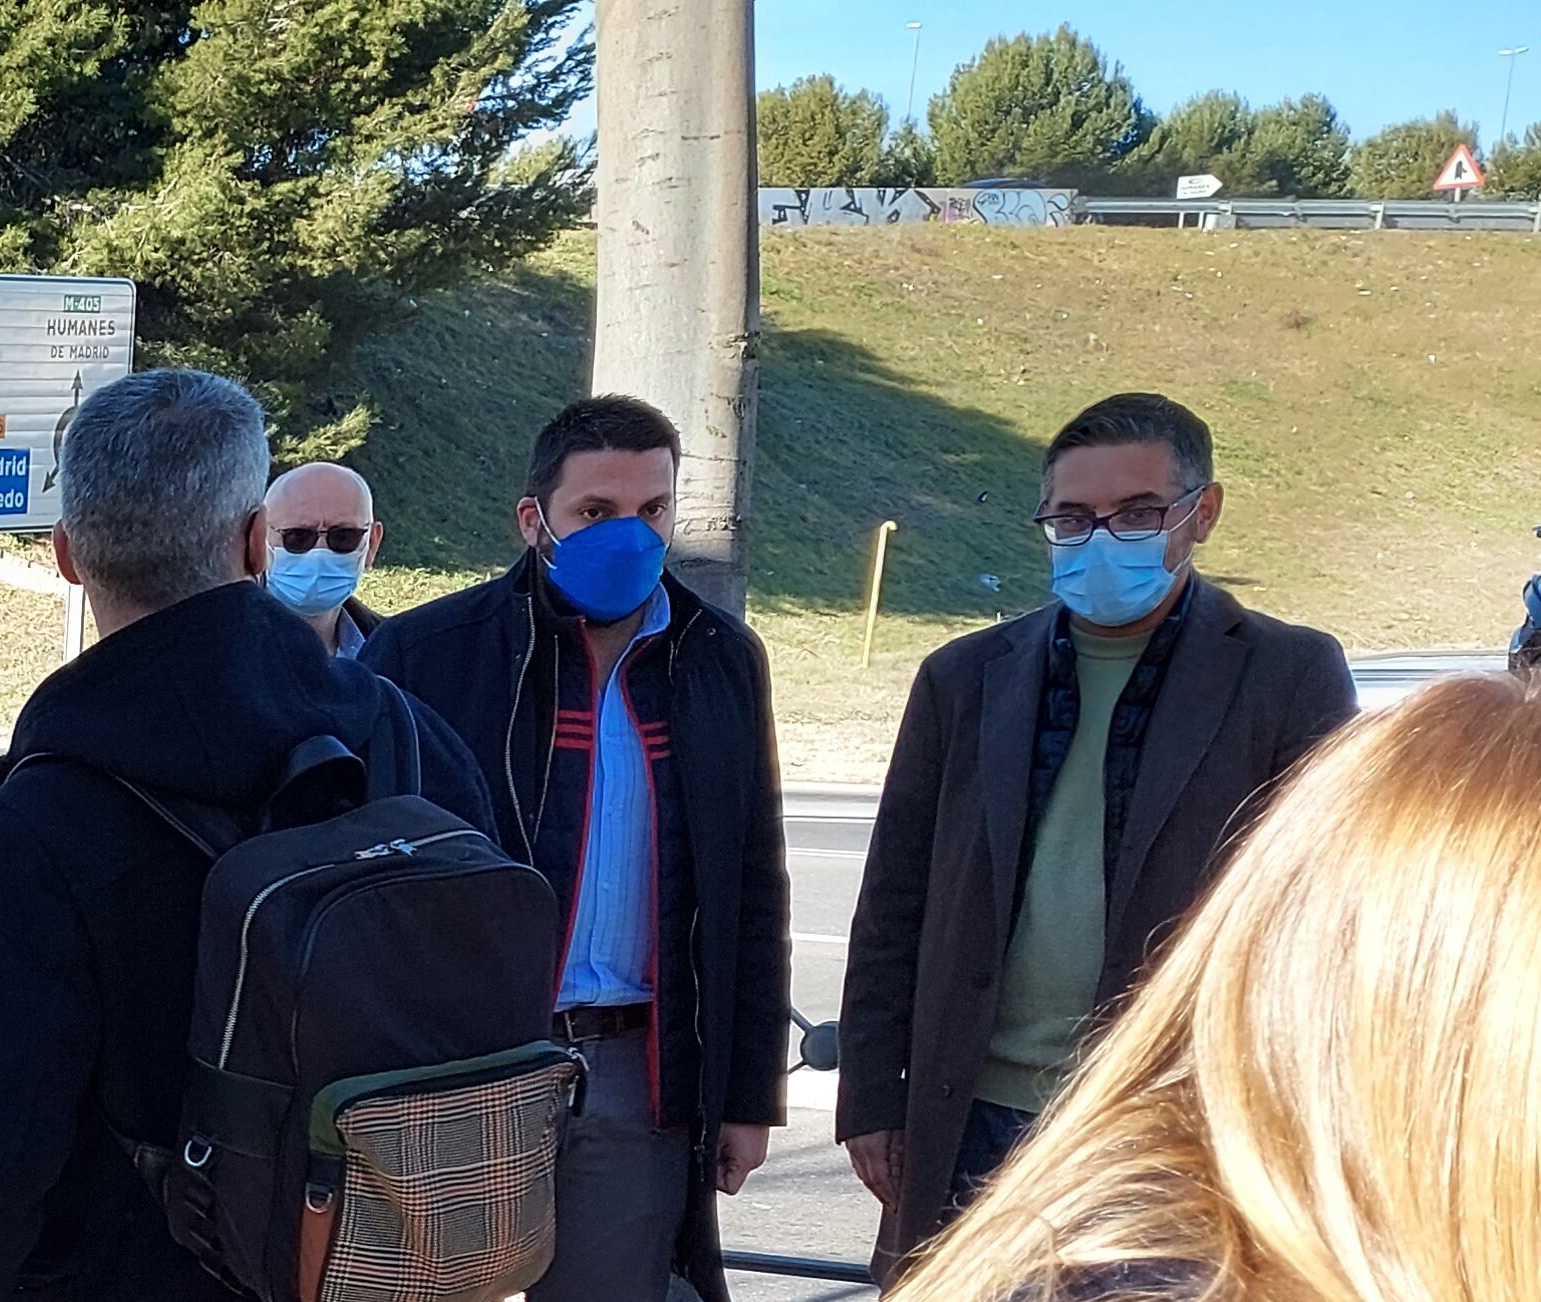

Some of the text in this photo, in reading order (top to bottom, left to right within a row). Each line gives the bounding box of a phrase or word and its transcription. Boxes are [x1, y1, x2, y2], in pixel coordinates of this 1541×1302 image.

[64, 296, 101, 312] M-405
[47, 319, 115, 337] HUMANES
[50, 344, 109, 359] DE MADRID
